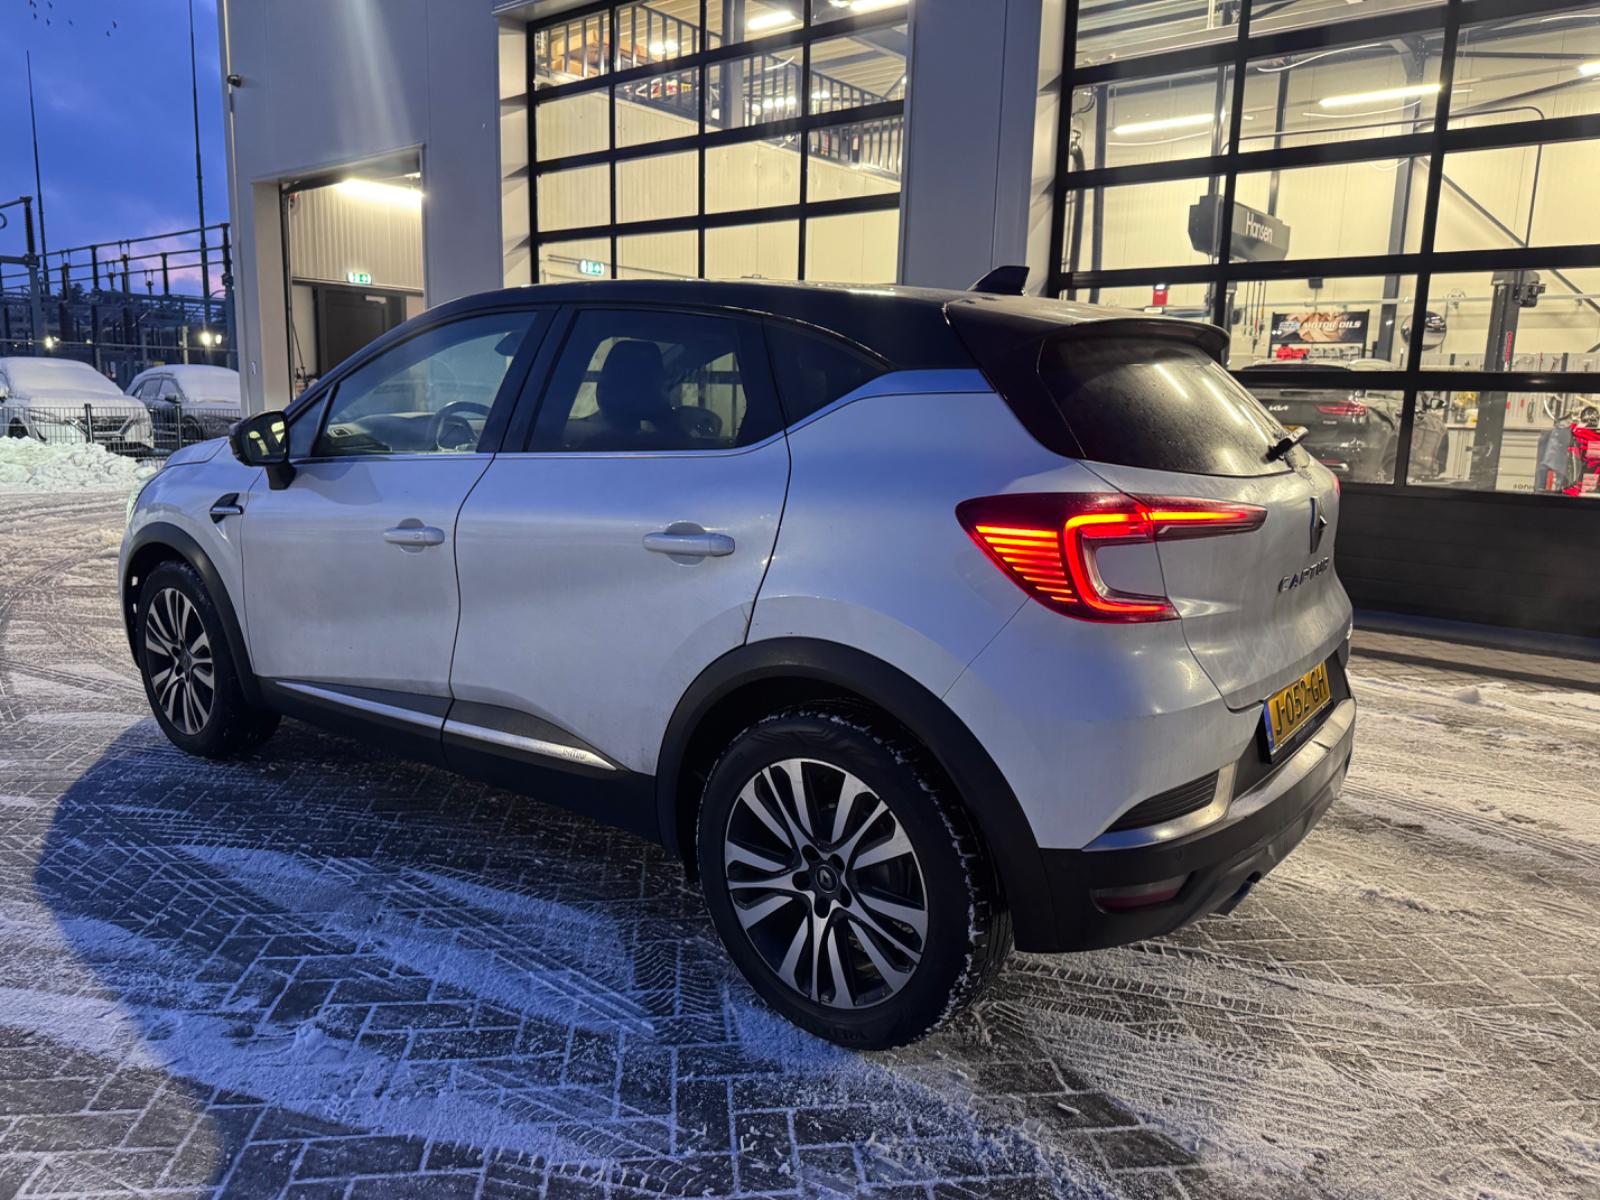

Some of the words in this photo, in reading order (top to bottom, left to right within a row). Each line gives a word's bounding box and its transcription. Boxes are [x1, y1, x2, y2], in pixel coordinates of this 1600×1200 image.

[1245, 210, 1273, 245] Hansen
[1303, 320, 1337, 330] MOTOR
[1338, 319, 1362, 330] OILS
[1274, 662, 1327, 737] J-052-GH
